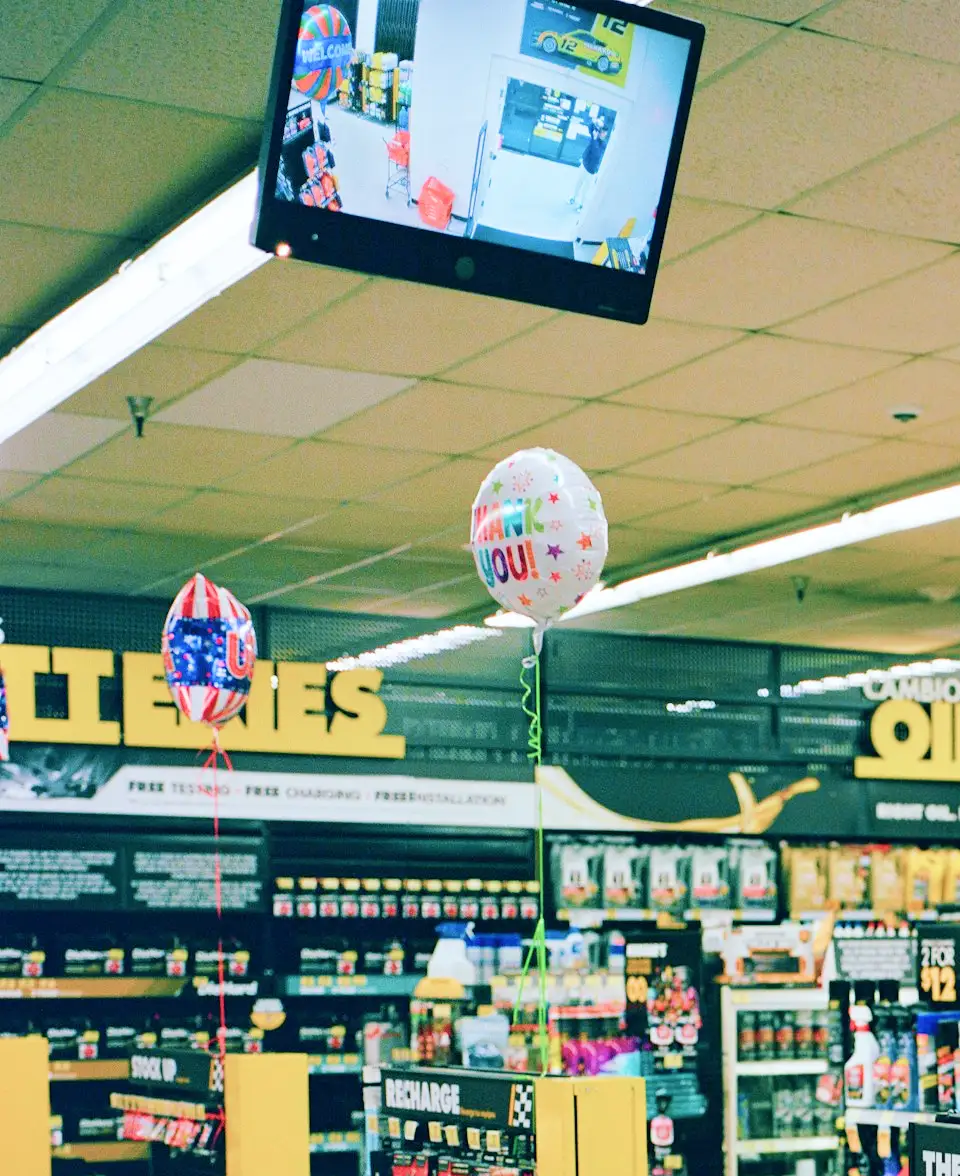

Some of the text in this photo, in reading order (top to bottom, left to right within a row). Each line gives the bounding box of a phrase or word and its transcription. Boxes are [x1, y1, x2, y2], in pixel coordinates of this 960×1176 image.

[562, 37, 578, 52] 12
[478, 539, 540, 588] YOU!
[921, 947, 930, 967] 2
[920, 966, 956, 1002] $12
[385, 1078, 460, 1116] RECHARGE
